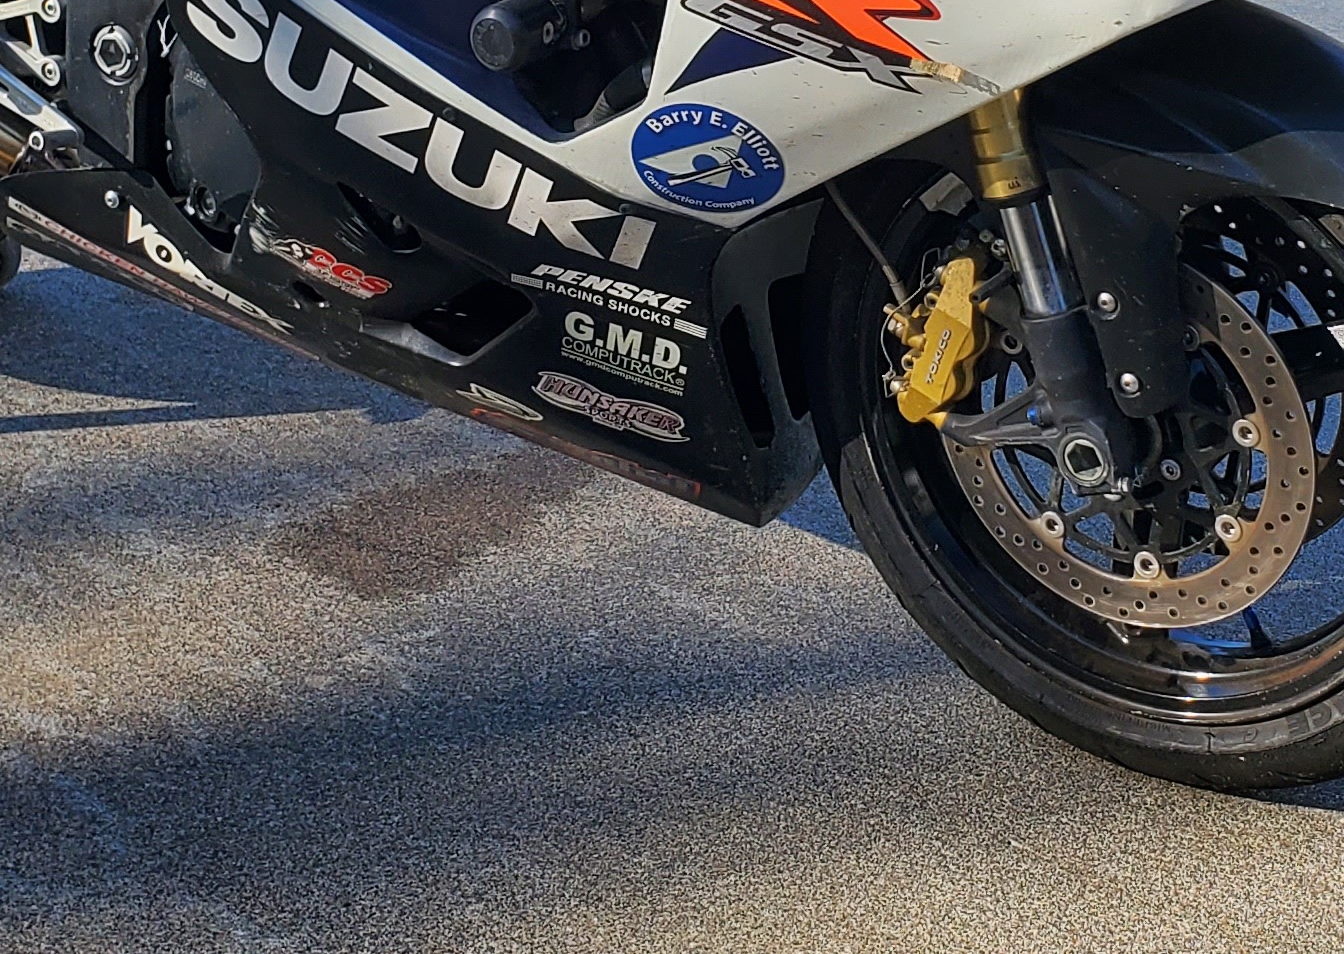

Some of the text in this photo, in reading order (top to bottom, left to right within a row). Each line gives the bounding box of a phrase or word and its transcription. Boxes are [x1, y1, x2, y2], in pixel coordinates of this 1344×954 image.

[645, 109, 780, 171] Barry E. Elliott
[643, 170, 755, 209] Construction Company
[127, 204, 295, 336] VORTEX
[306, 247, 393, 295] CCS
[531, 263, 692, 315] PENSKE
[545, 281, 672, 327] RACING SHOCKS
[564, 310, 688, 376] G.M.D.
[926, 328, 952, 385] TOKICO
[560, 351, 684, 397] www.gmdcomputrack.com
[540, 374, 684, 434] HUNSAKER
[583, 404, 633, 429] SPORTS
